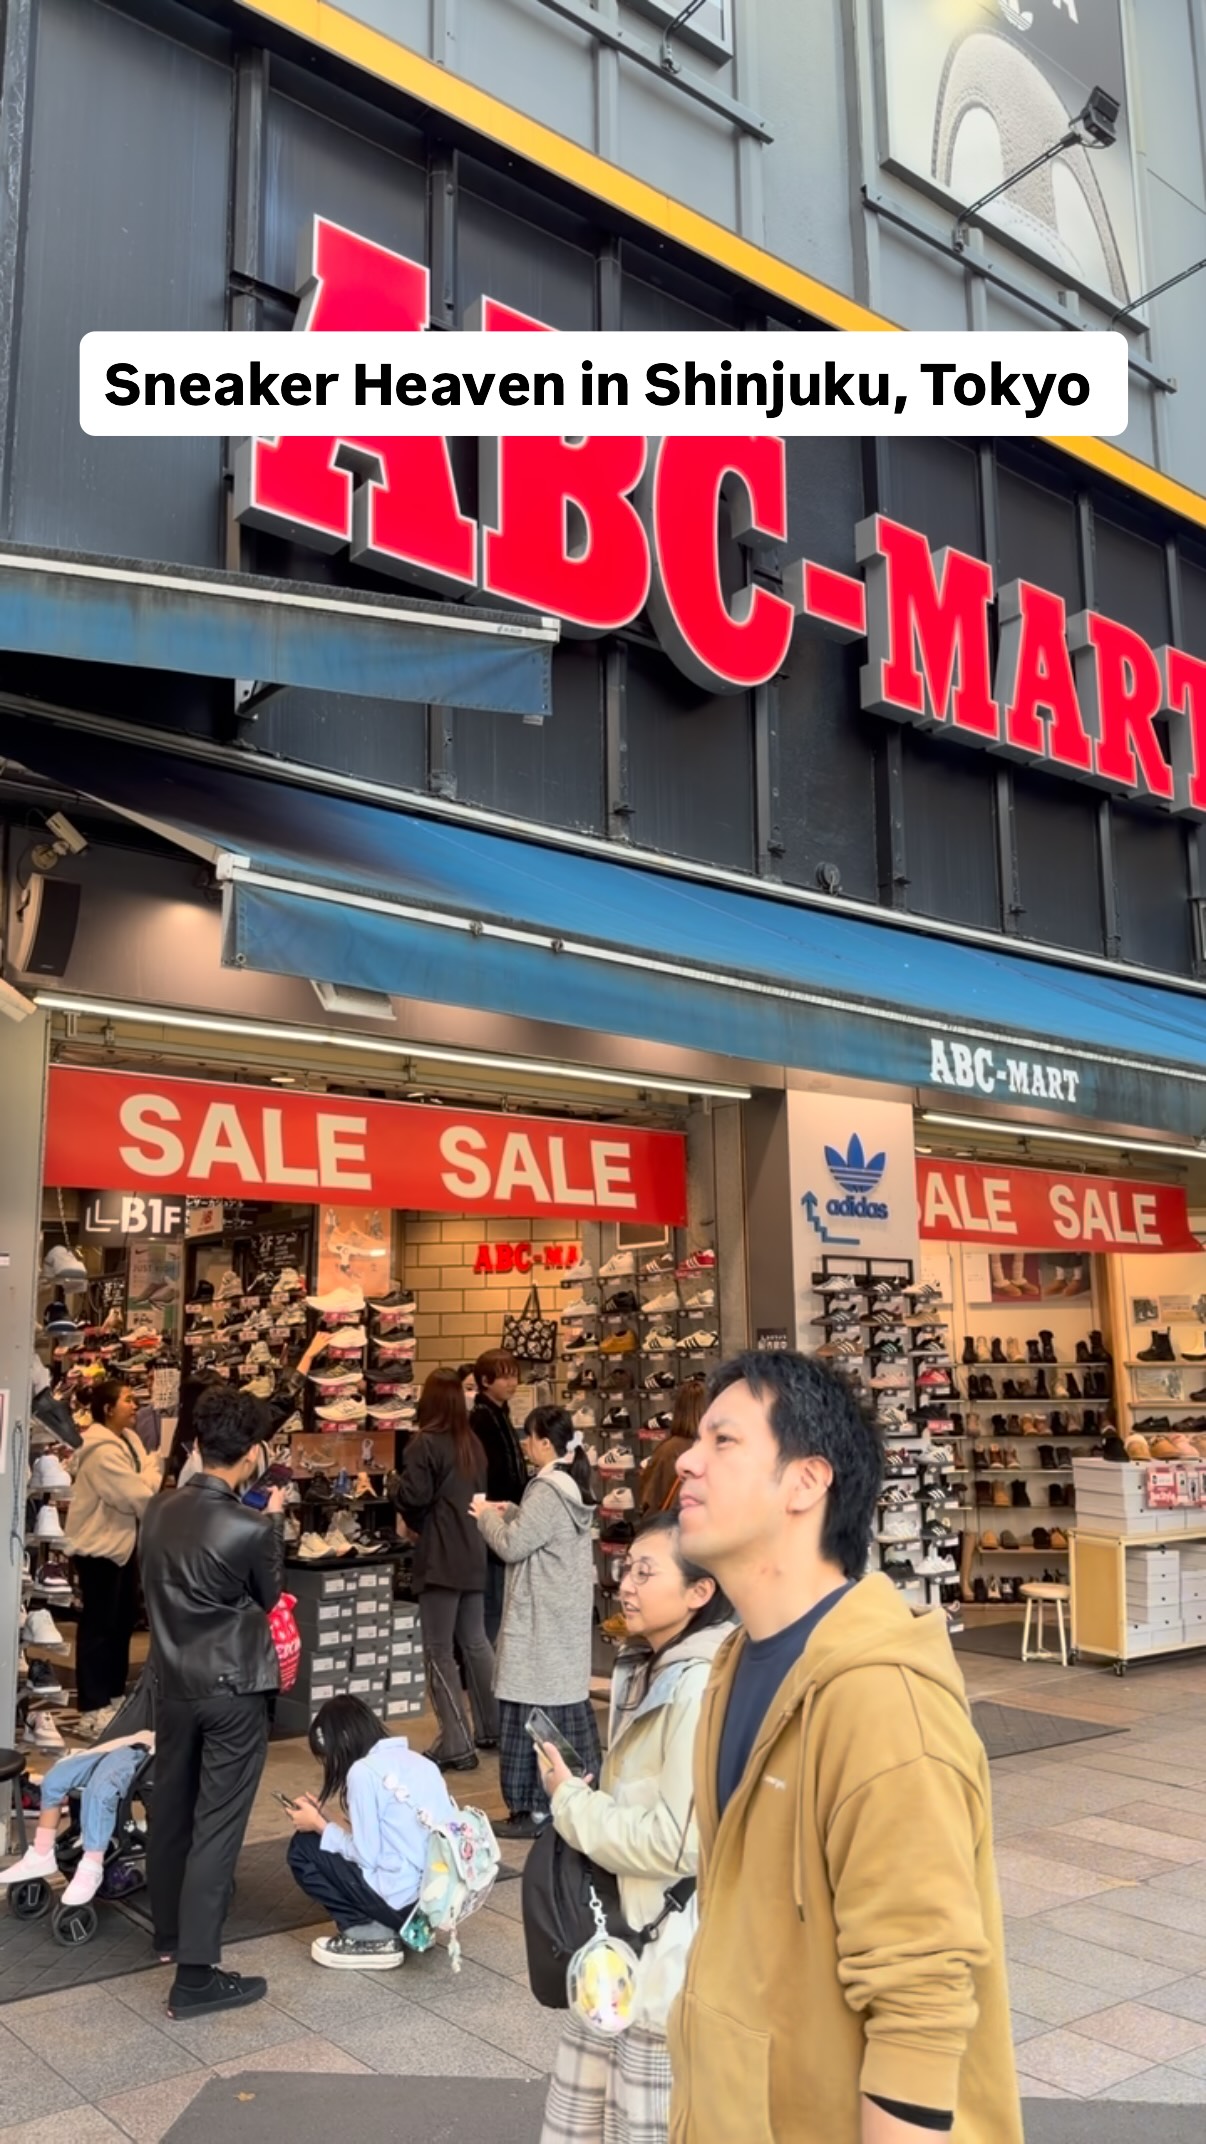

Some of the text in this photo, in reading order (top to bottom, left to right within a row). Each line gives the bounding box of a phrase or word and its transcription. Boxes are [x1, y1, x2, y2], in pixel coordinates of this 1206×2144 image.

[930, 1038, 1080, 1103] ABC-MART
[119, 1093, 637, 1209] SALE SALE
[121, 1196, 182, 1235] B1F
[826, 1195, 889, 1220] adidas
[917, 1172, 1163, 1246] ALE SALE
